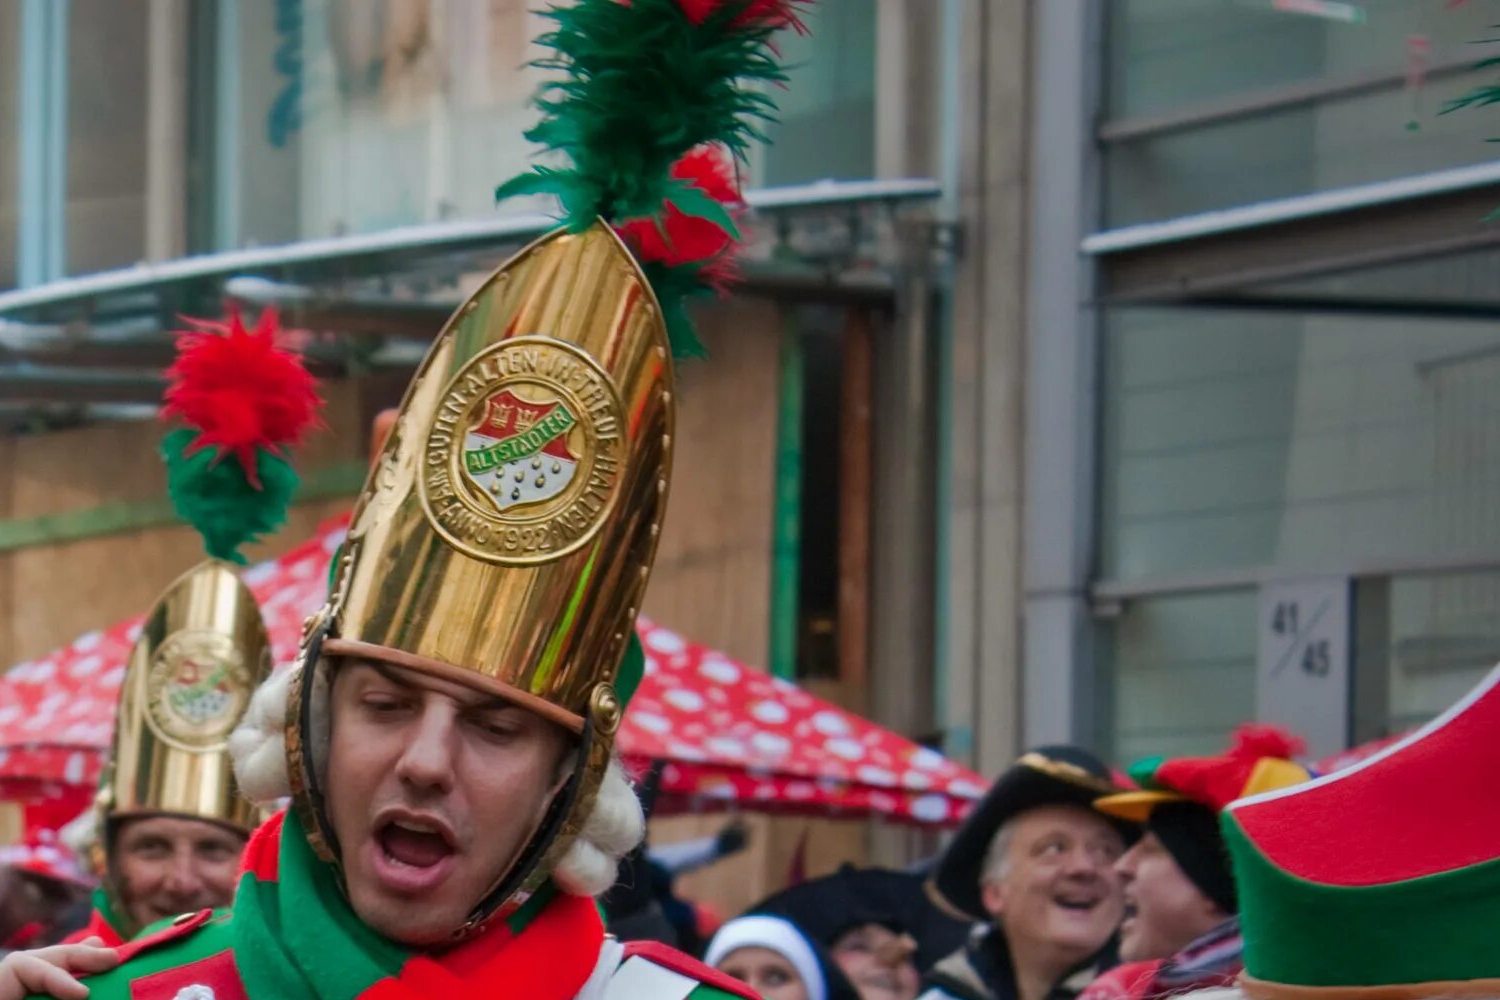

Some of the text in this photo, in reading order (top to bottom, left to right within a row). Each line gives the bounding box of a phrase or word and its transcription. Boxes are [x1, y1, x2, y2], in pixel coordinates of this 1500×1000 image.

[464, 350, 539, 395] ALTEN
[550, 353, 578, 385] IN
[427, 391, 468, 466] GUTEN
[555, 453, 619, 538] HALTEN
[494, 525, 552, 551] 1922
[1272, 601, 1299, 635] 41
[1301, 641, 1330, 678] 45
